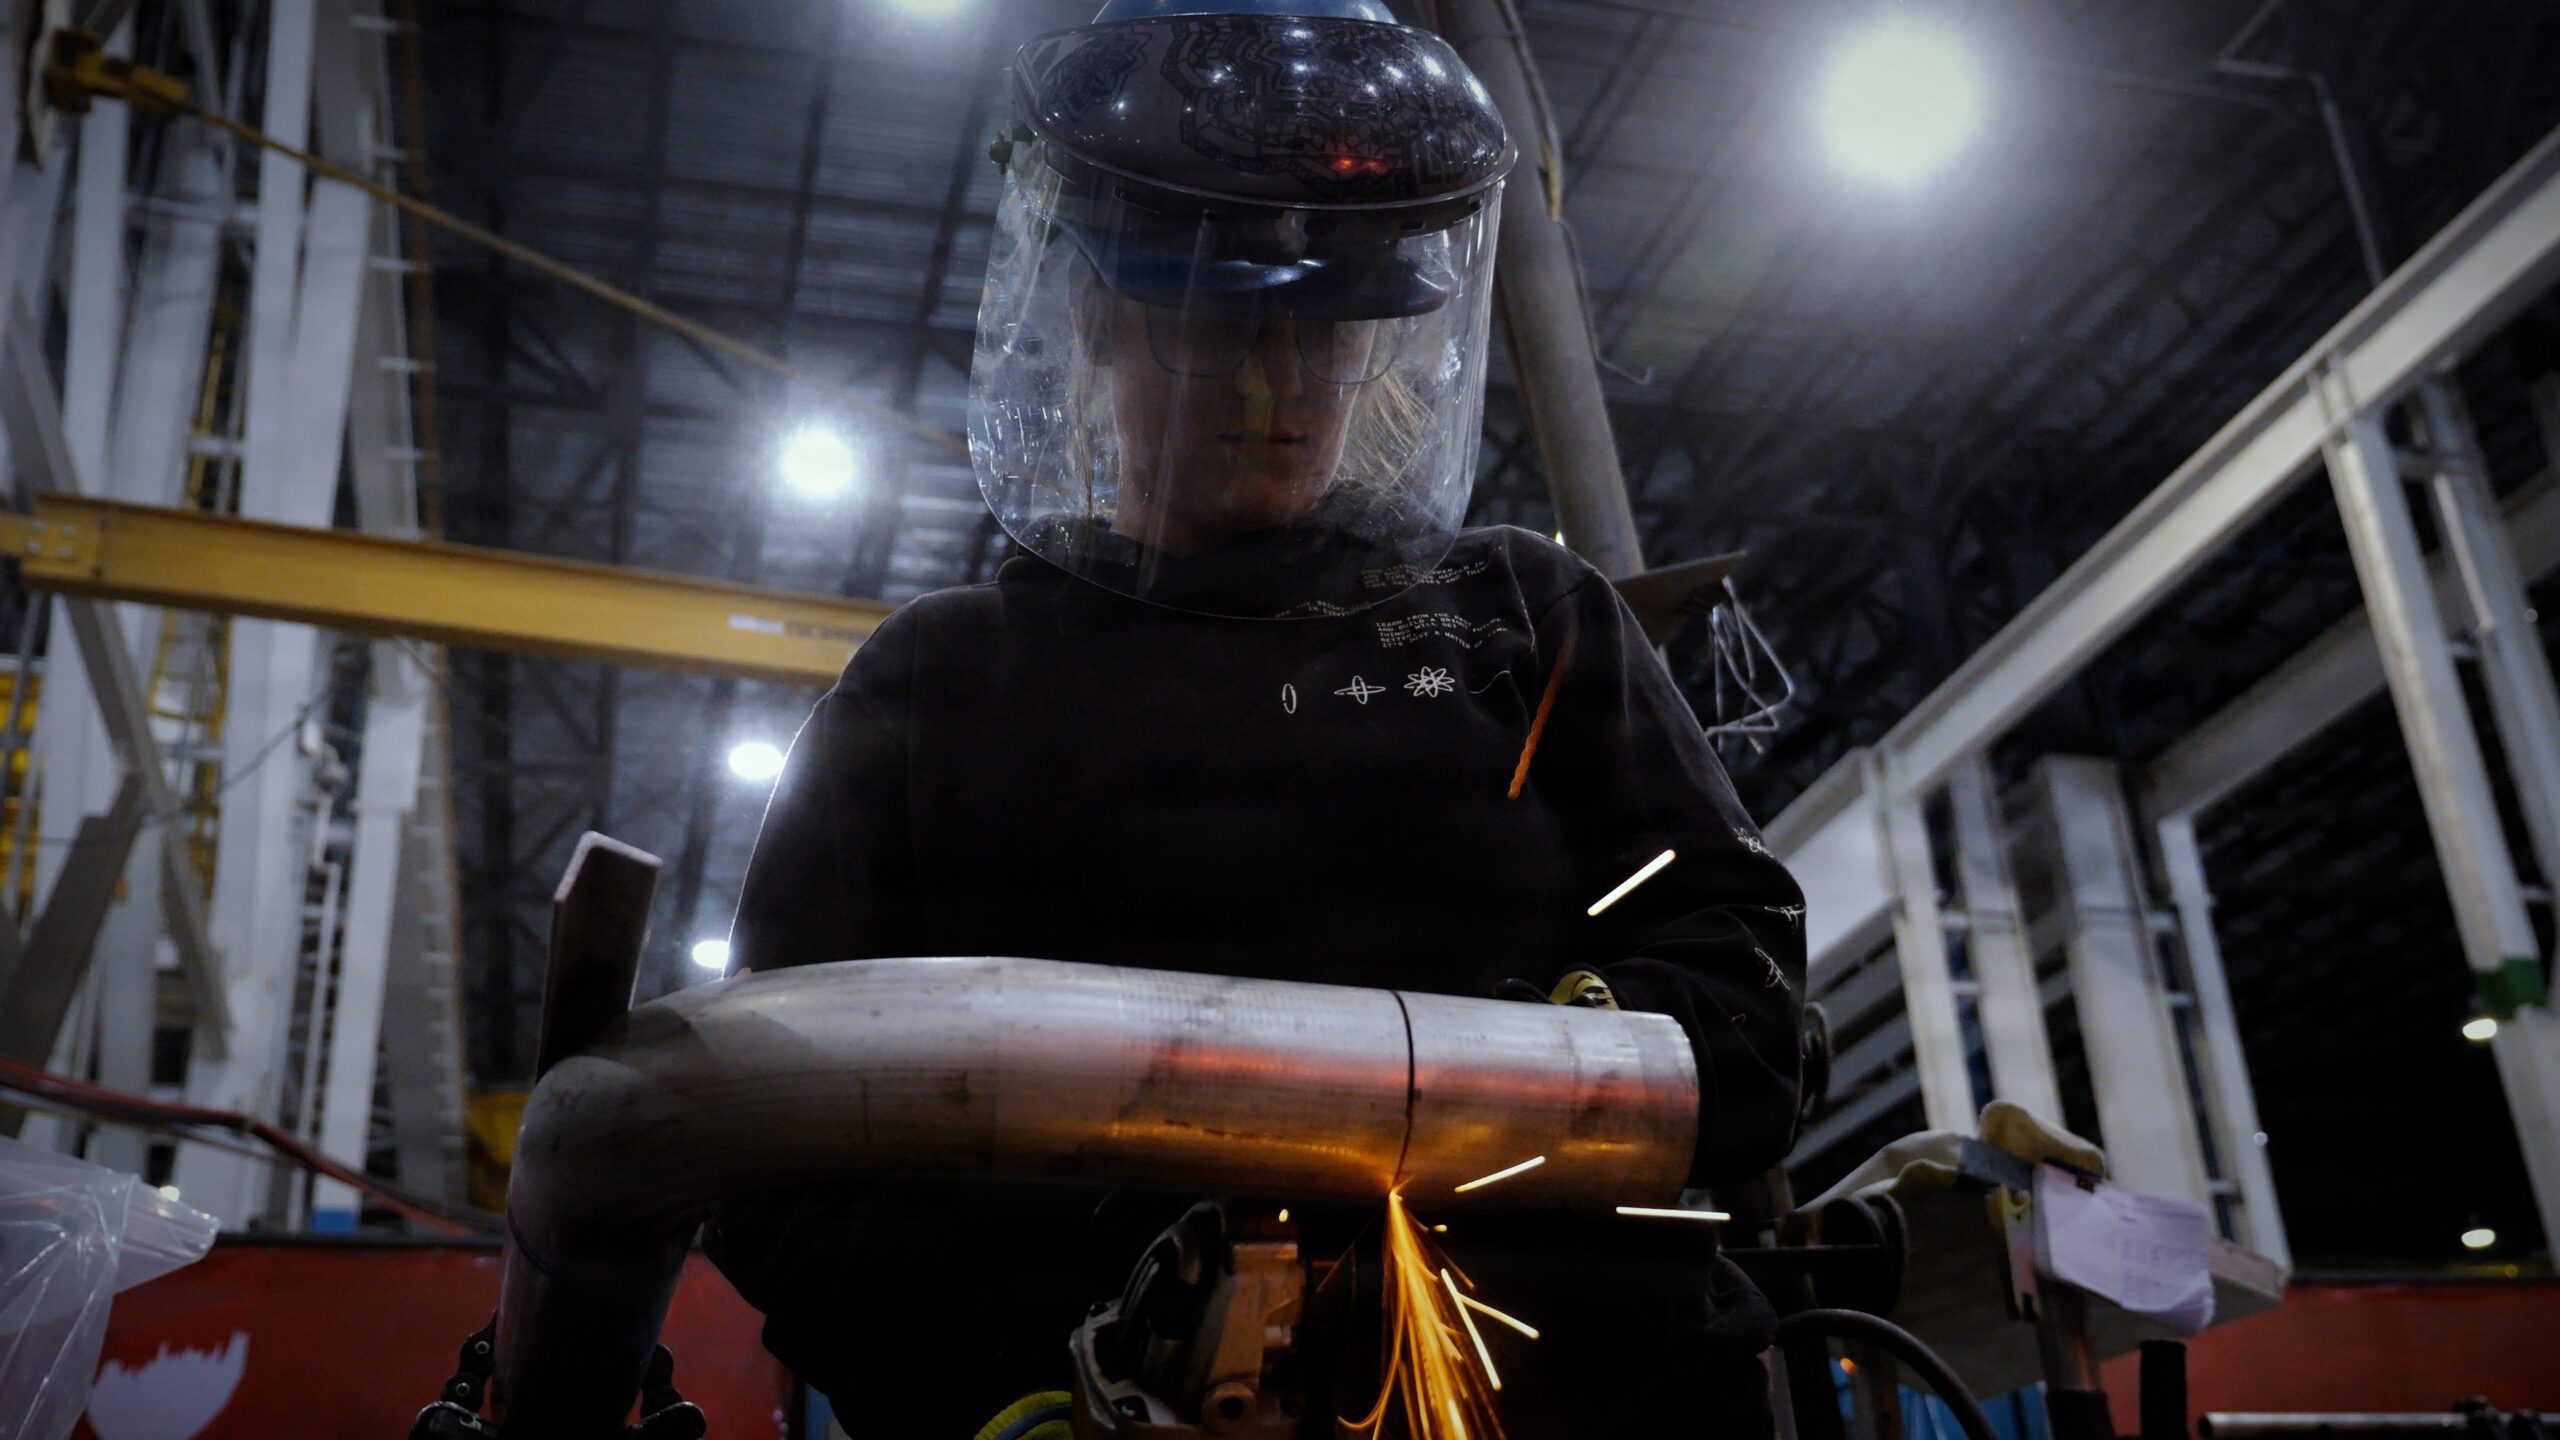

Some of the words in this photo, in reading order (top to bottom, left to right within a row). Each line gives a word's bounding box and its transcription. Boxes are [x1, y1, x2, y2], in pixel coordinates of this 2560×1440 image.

[1376, 619, 1402, 627] LEARN
[1406, 613, 1429, 621] FROM
[1397, 618, 1425, 630] BUILD
[1380, 629, 1411, 638] THINGS
[1414, 621, 1438, 630] WILL
[1441, 622, 1456, 630] GET
[1409, 631, 1429, 643] JUST
[1444, 631, 1472, 650] MATTER
